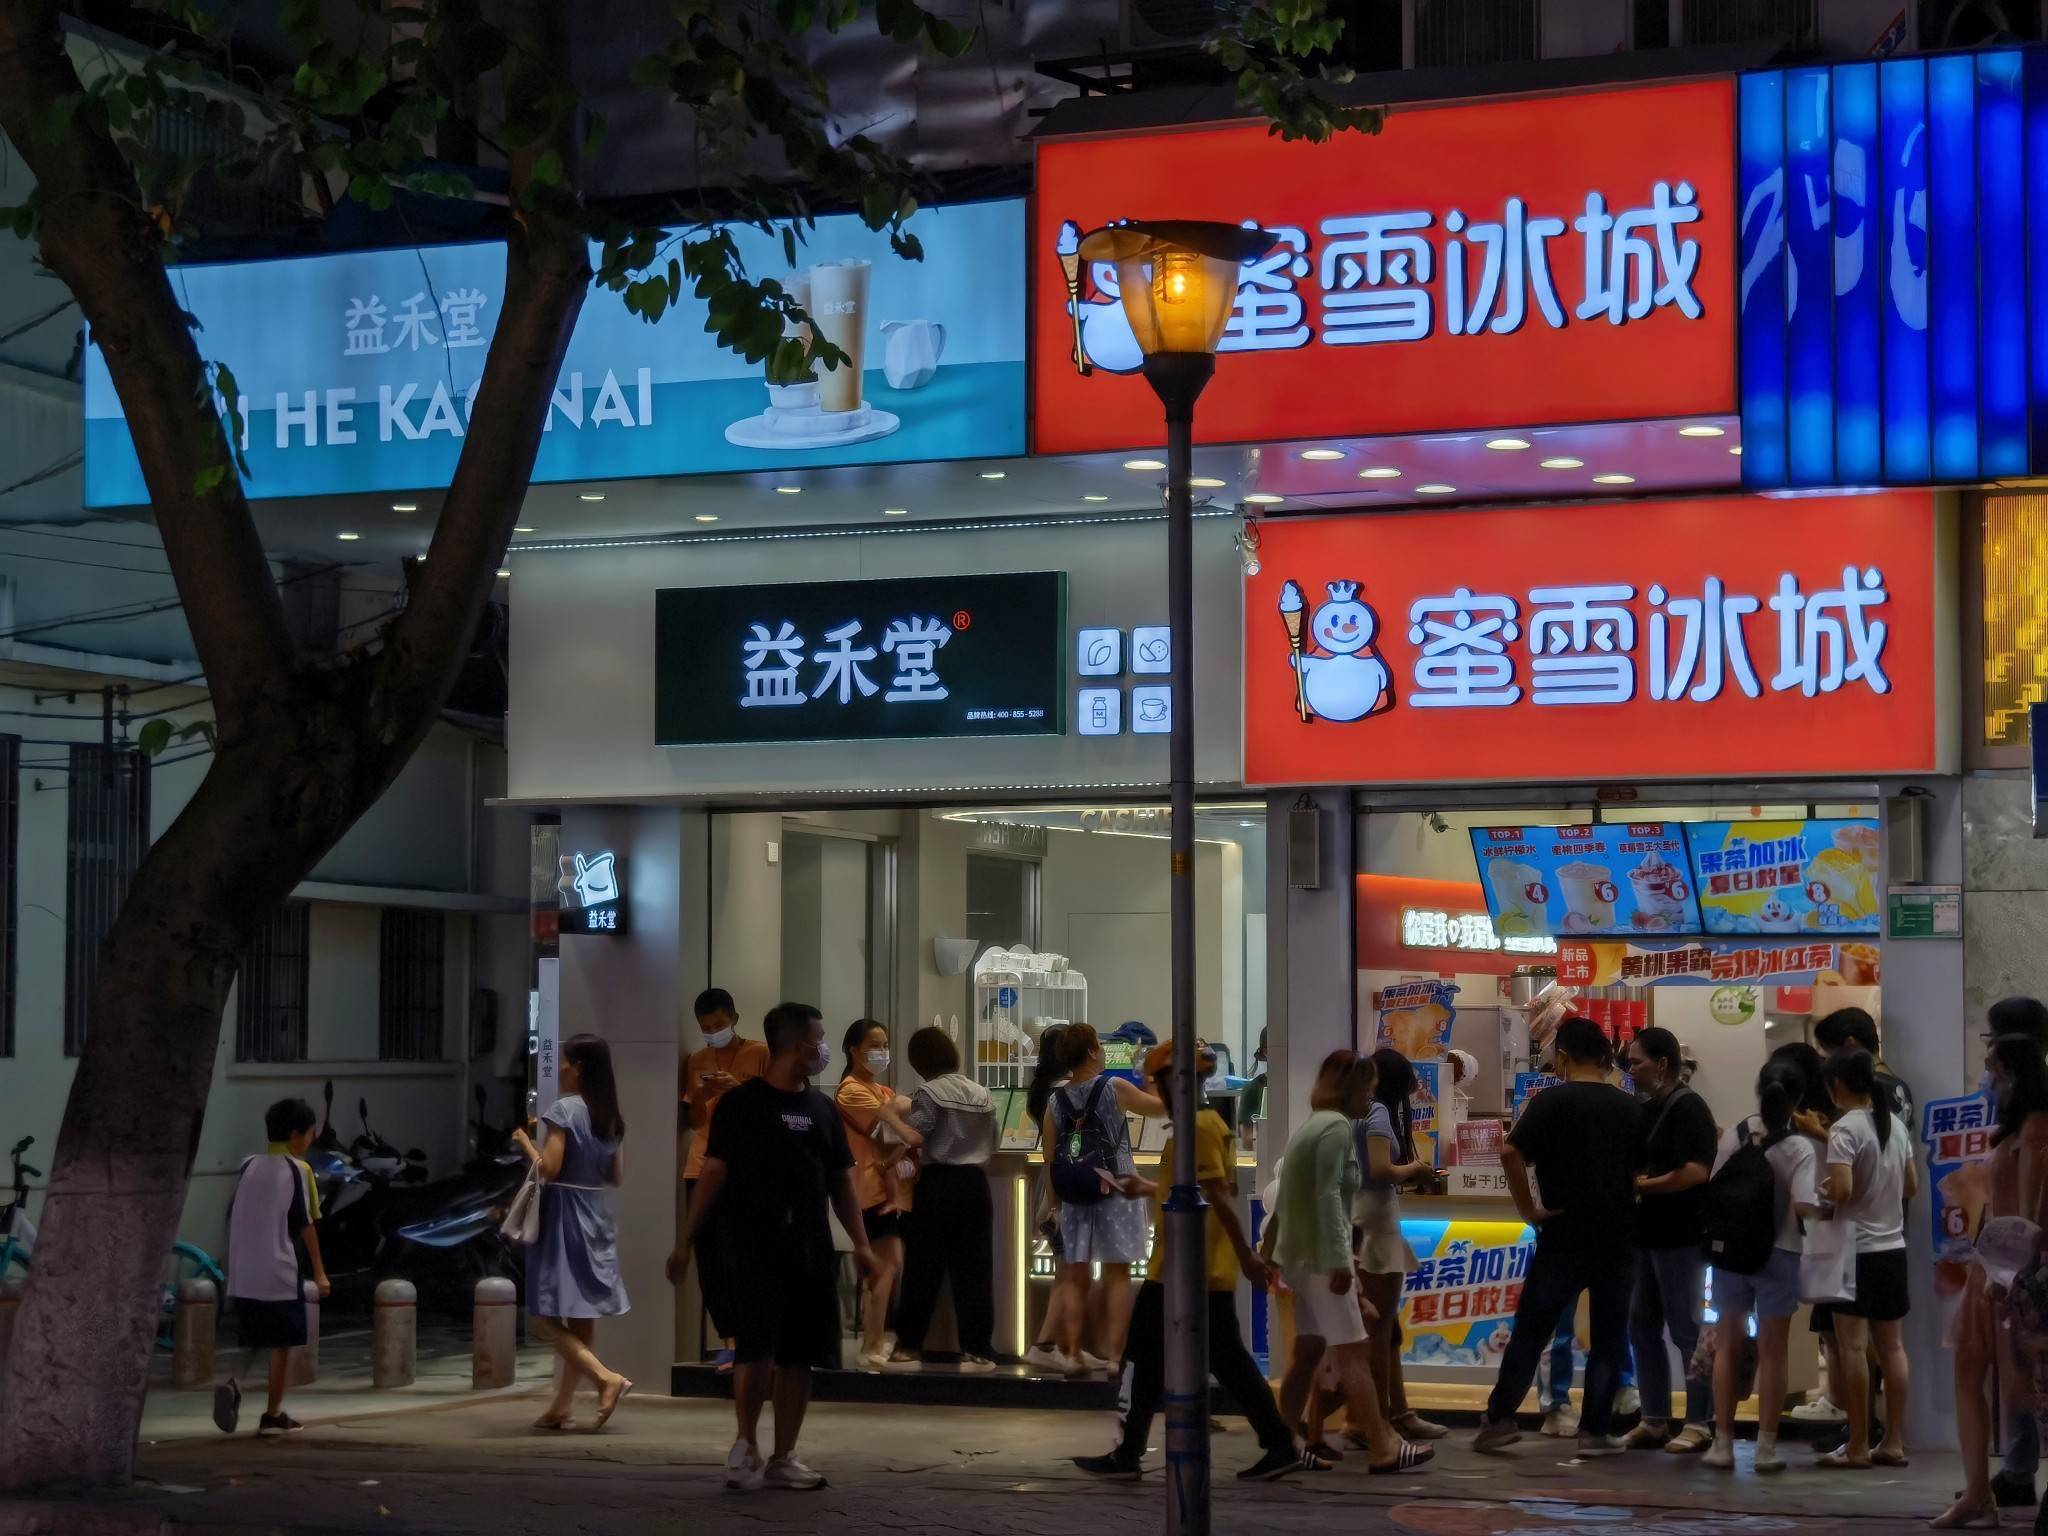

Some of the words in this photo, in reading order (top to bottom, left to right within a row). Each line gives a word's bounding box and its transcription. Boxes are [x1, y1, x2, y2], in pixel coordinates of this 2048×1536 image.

[344, 287, 488, 356] 益禾堂
[276, 388, 356, 448] HE
[379, 376, 479, 442] KA
[1408, 565, 1891, 709] 蜜雪冰城
[740, 617, 953, 708] 益禾堂
[1491, 830, 1521, 840] TOP.1
[1560, 828, 1590, 838] TOP.2
[1631, 825, 1661, 835] TOP.3
[1482, 844, 1536, 857] 冰鲜柠檬水
[1551, 842, 1606, 856] 蜜桃四季春
[1700, 836, 1807, 875] 果茶加冰
[588, 910, 617, 929] 益禾堂
[1562, 948, 1588, 961] 新品
[1562, 965, 1589, 979] 上市
[1384, 983, 1435, 999] 果茶加冰
[542, 1038, 553, 1078] 益禾堂
[1462, 1174, 1511, 1190] 始于19
